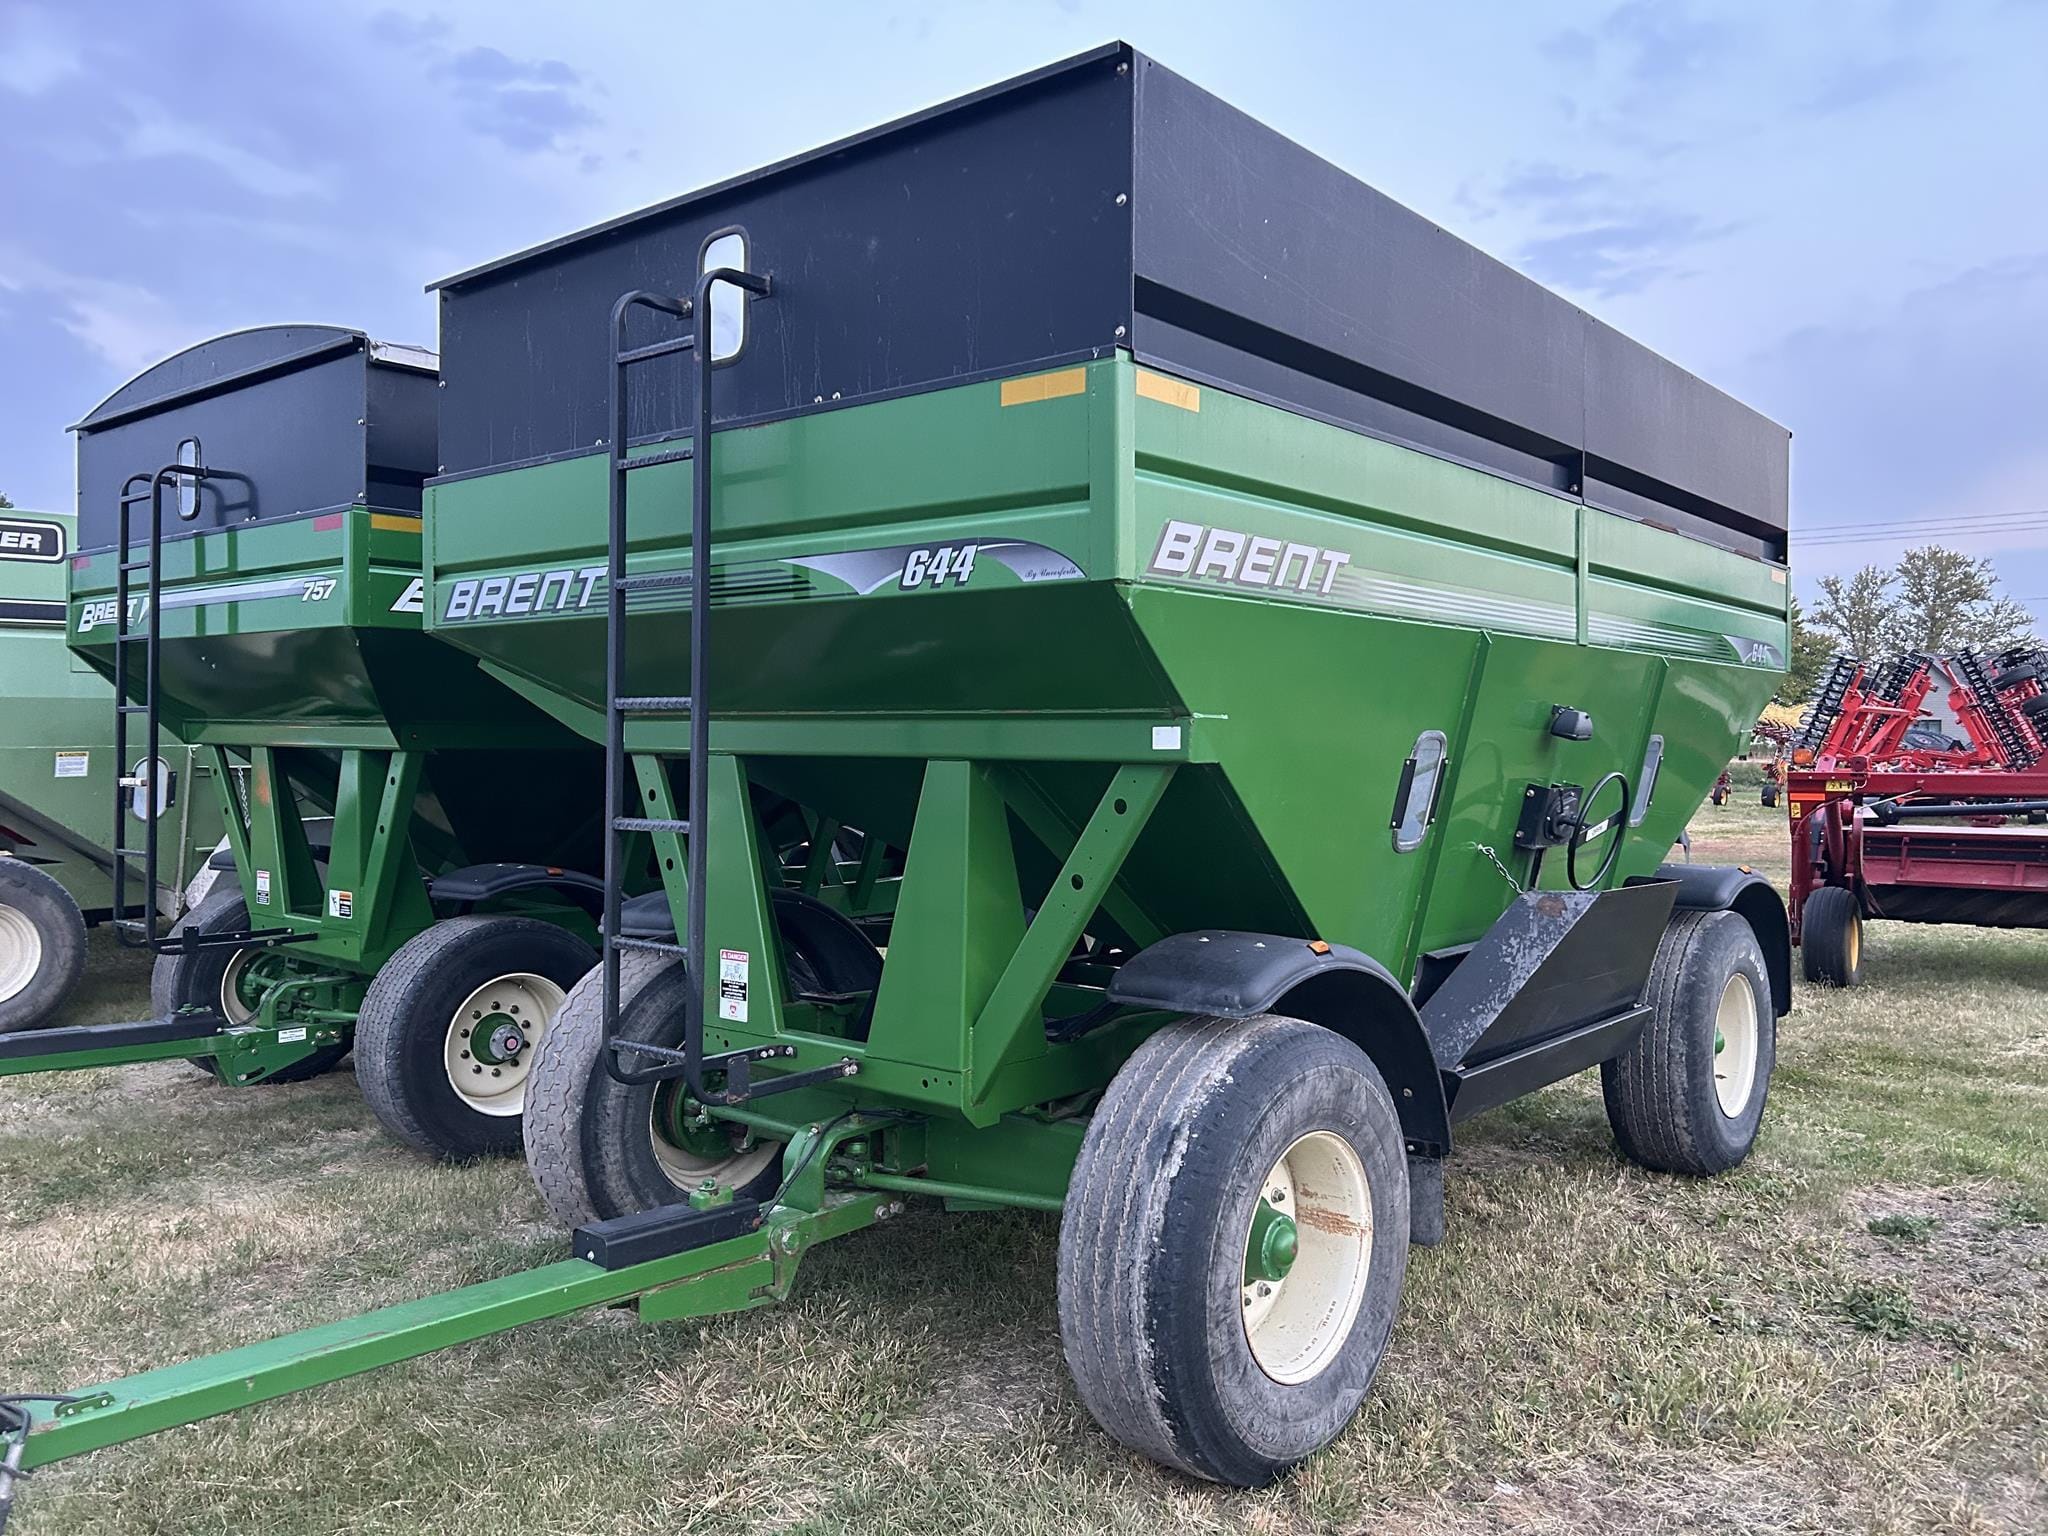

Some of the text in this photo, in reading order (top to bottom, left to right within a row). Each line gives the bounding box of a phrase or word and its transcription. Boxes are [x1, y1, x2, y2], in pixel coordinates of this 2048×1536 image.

[0, 531, 42, 549] ER
[900, 544, 979, 591] 644
[1146, 519, 1352, 597] BRENT
[302, 579, 337, 602] 757
[443, 566, 609, 620] BRENT
[77, 598, 138, 633] BRET
[1751, 642, 1768, 664] 644
